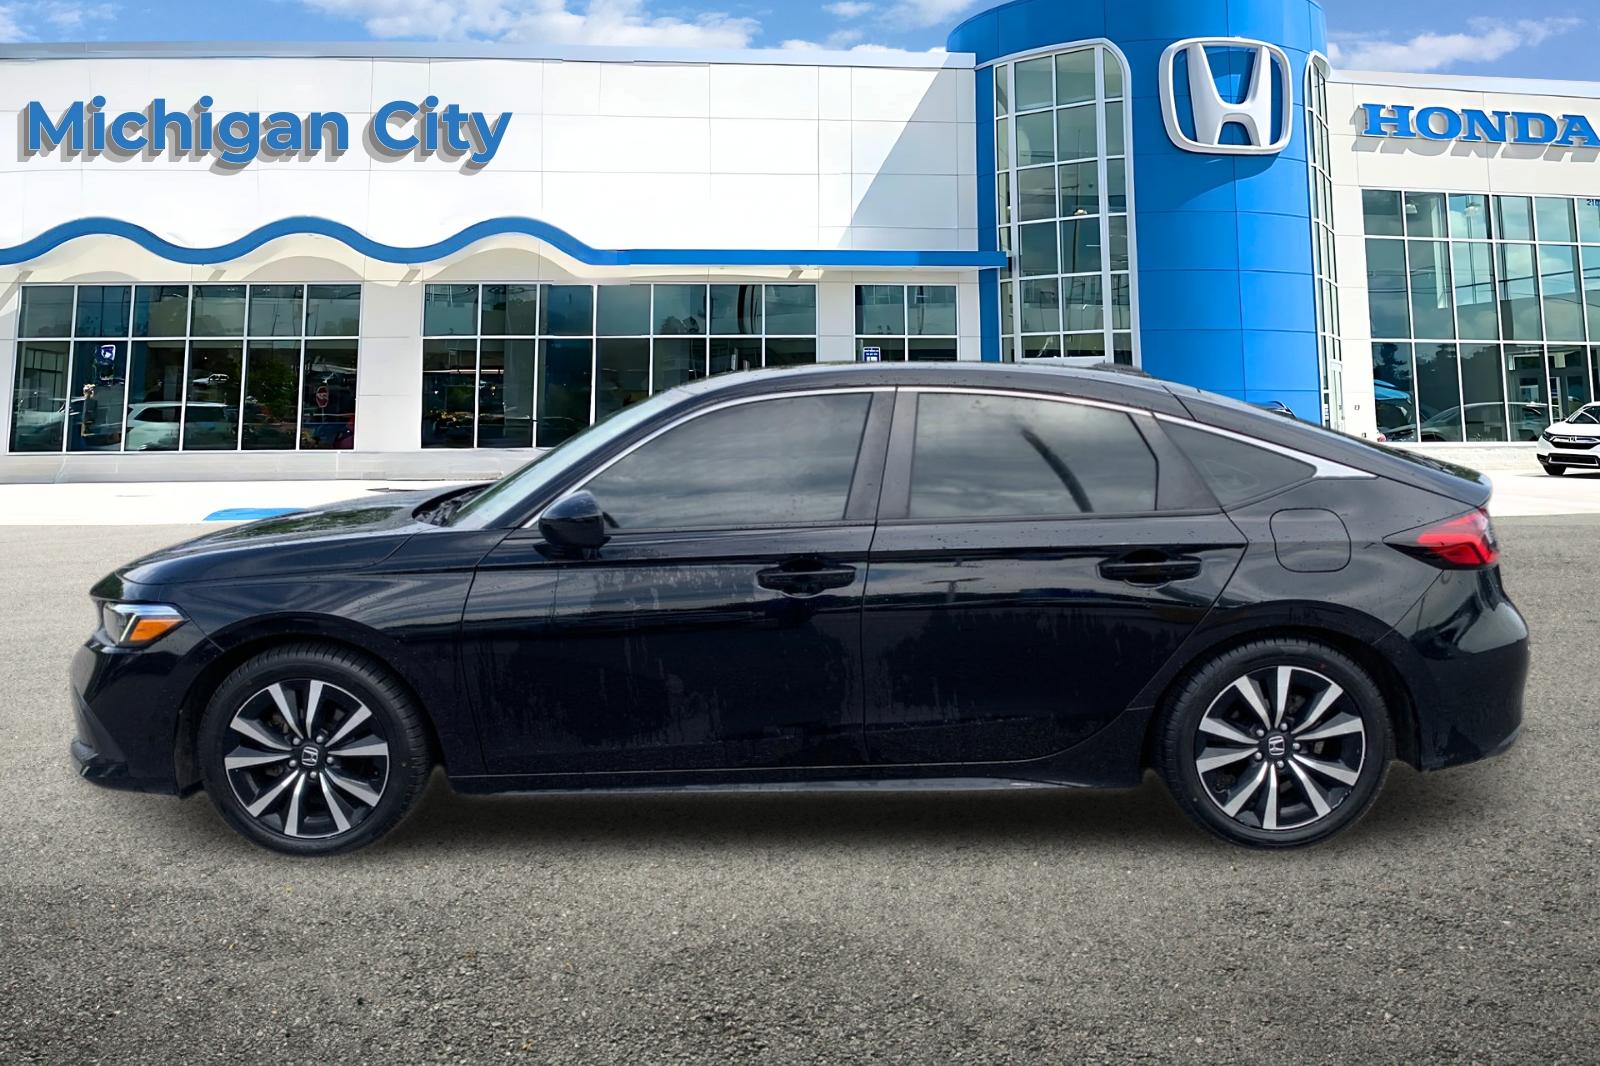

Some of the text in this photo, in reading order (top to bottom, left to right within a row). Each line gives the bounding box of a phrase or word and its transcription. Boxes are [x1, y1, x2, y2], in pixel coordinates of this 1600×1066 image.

[28, 95, 513, 164] Michigan City
[1361, 102, 1600, 148] HONDA
